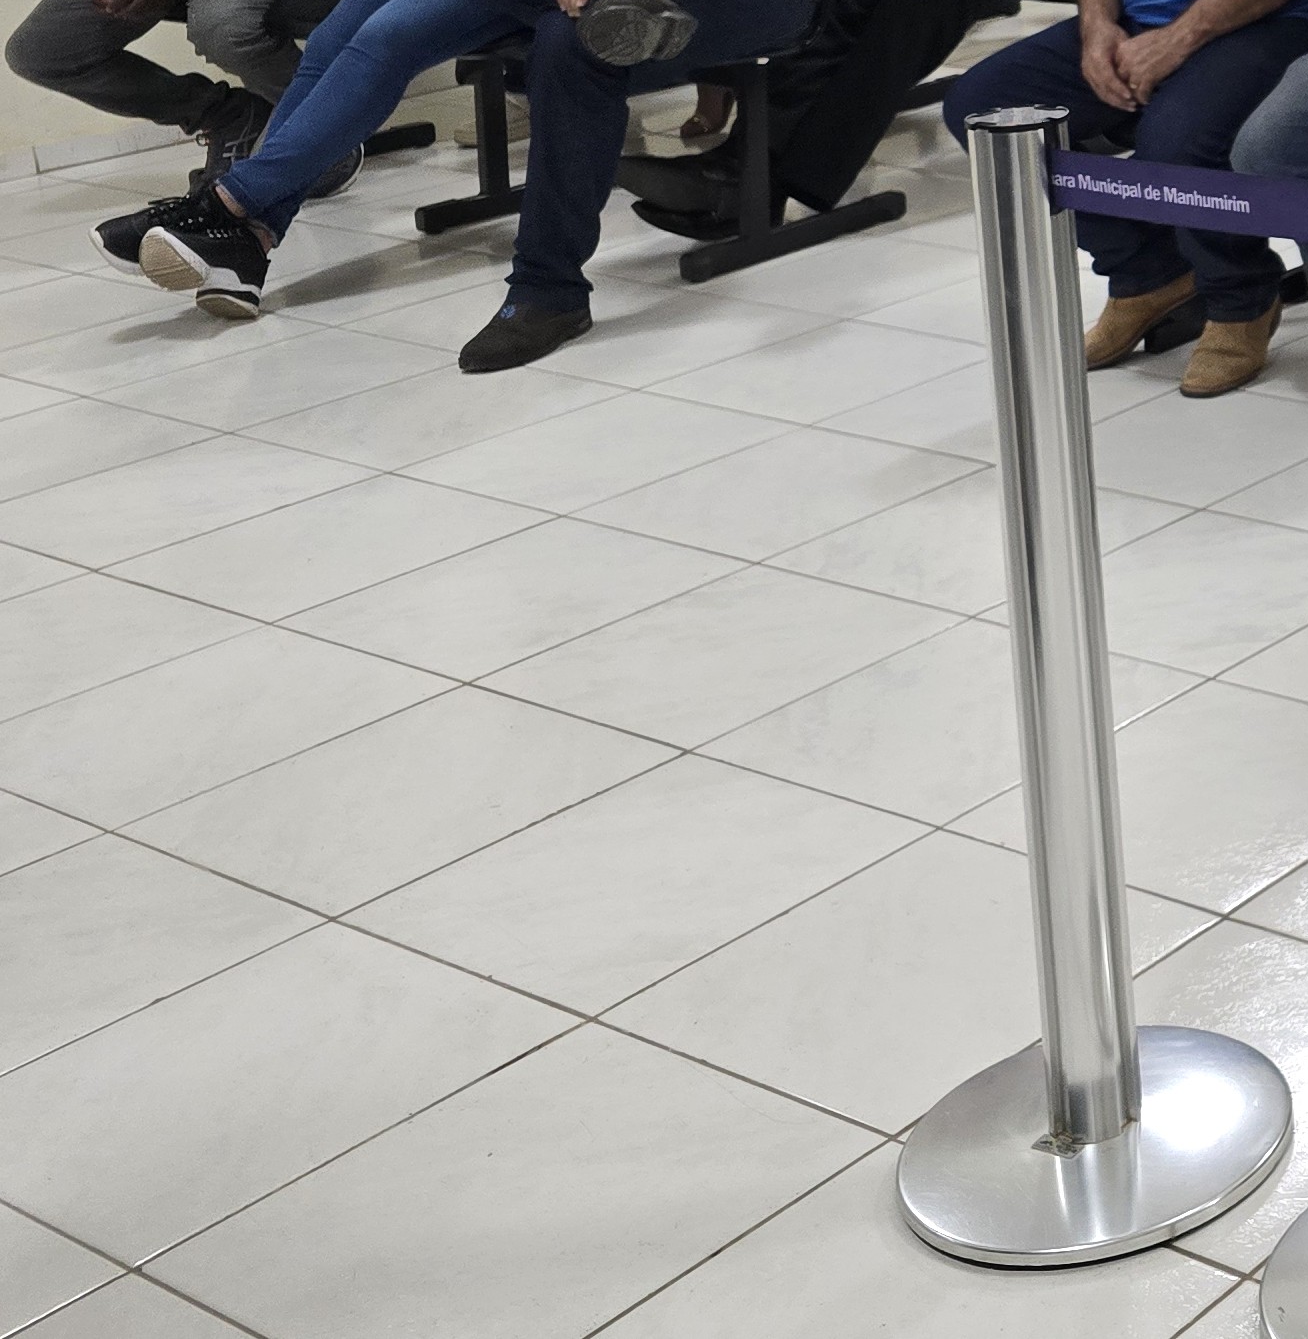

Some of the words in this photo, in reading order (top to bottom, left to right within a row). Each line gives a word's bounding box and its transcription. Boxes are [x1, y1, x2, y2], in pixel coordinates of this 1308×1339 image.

[1078, 174, 1142, 200] Municipal
[1144, 184, 1161, 200] de
[1164, 186, 1250, 214] Manhumirim
